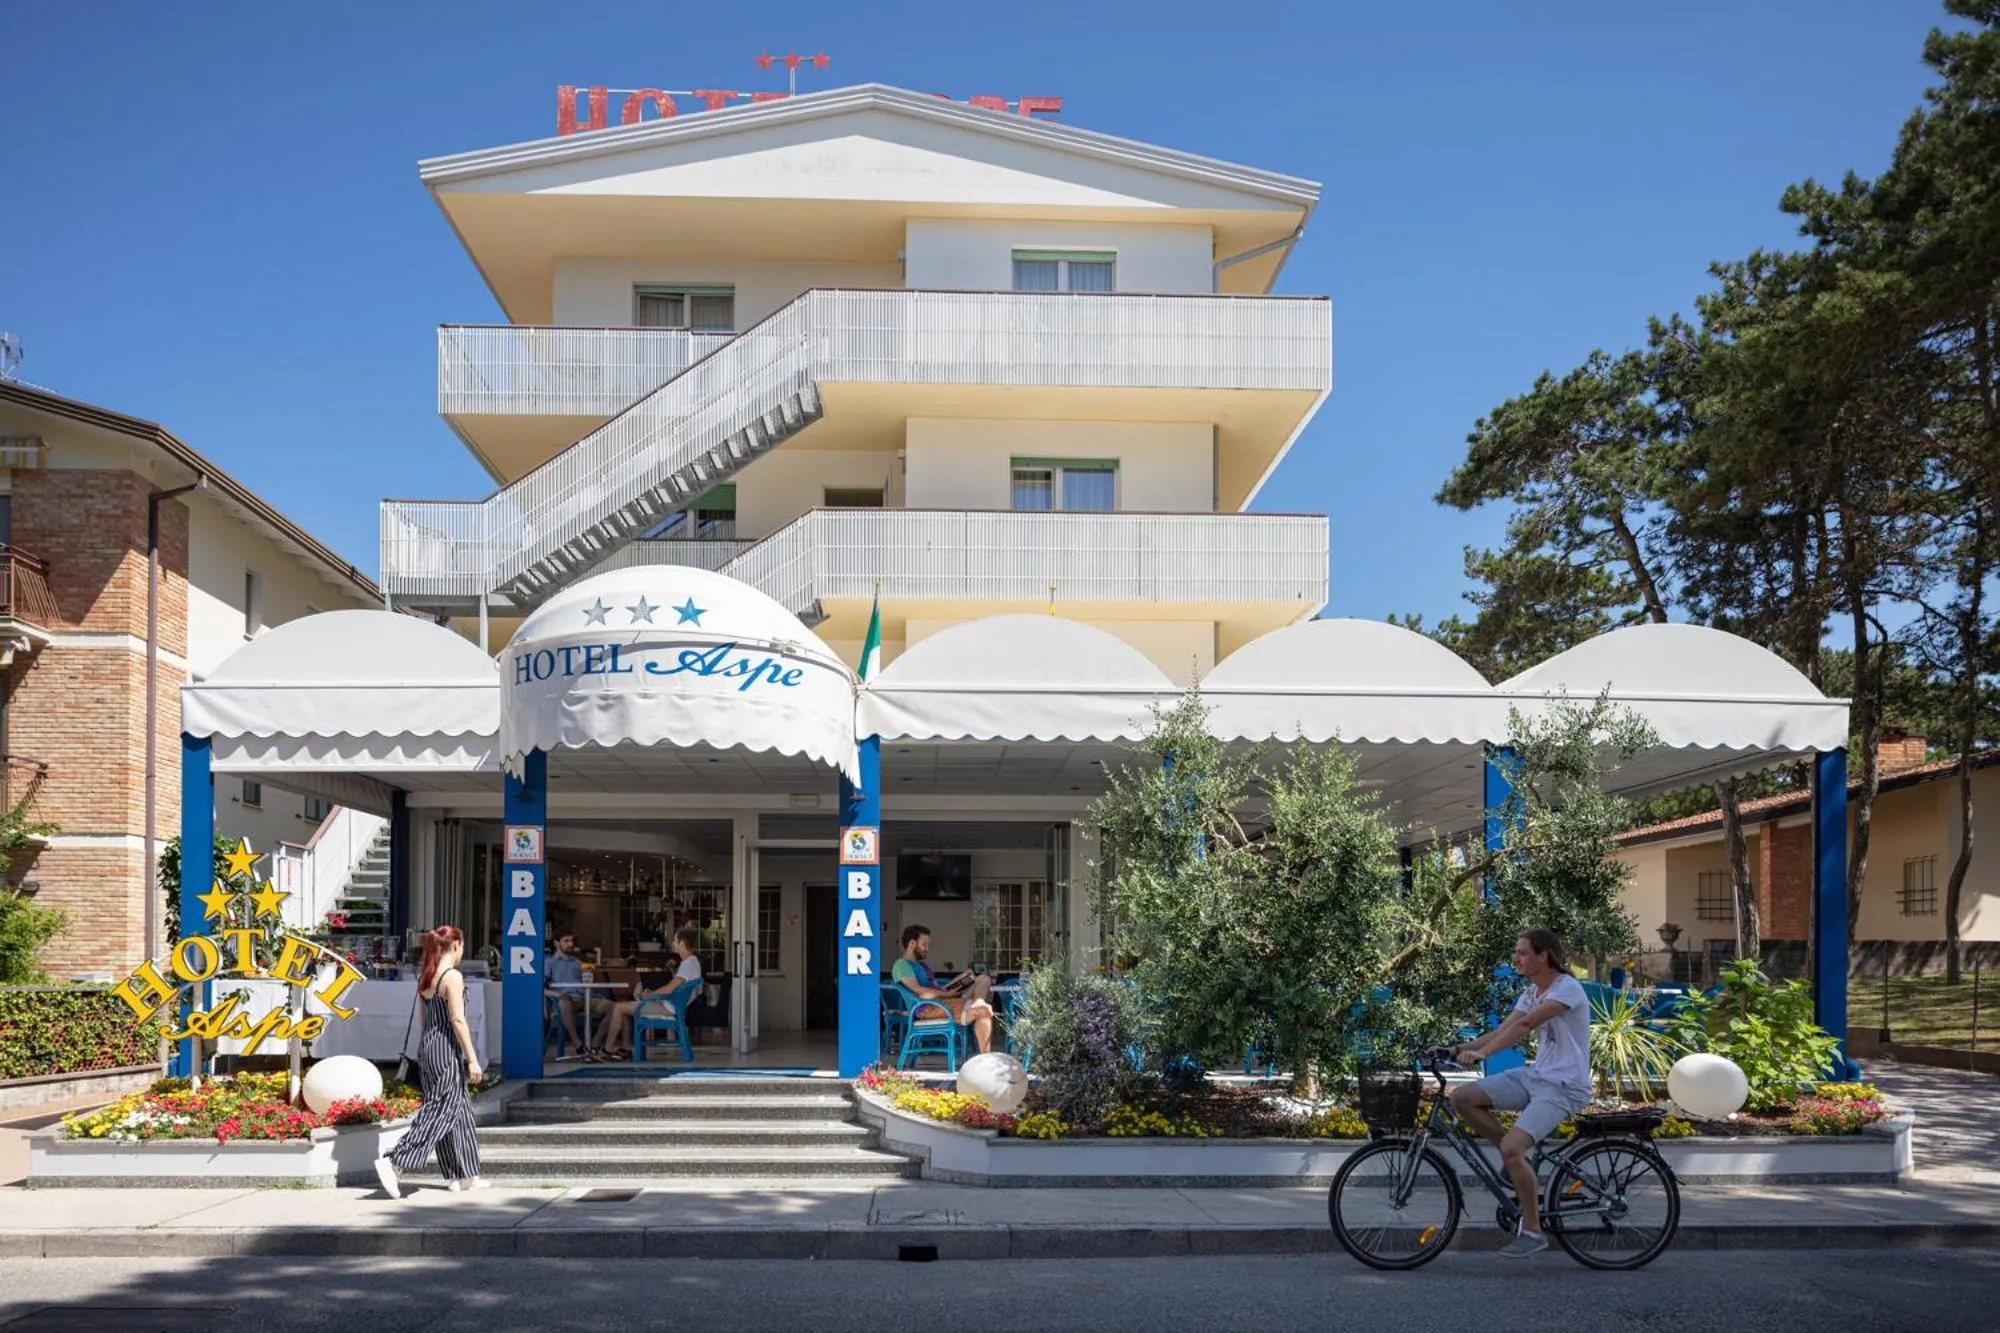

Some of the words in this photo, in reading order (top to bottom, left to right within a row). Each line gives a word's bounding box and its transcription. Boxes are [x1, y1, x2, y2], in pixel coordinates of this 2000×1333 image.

[513, 643, 634, 687] HOTEL
[645, 641, 805, 692] Aspe
[507, 869, 537, 975] BAR
[843, 871, 874, 975] BAR
[111, 928, 366, 1023] HOTEL
[159, 995, 326, 1057] Aspe
